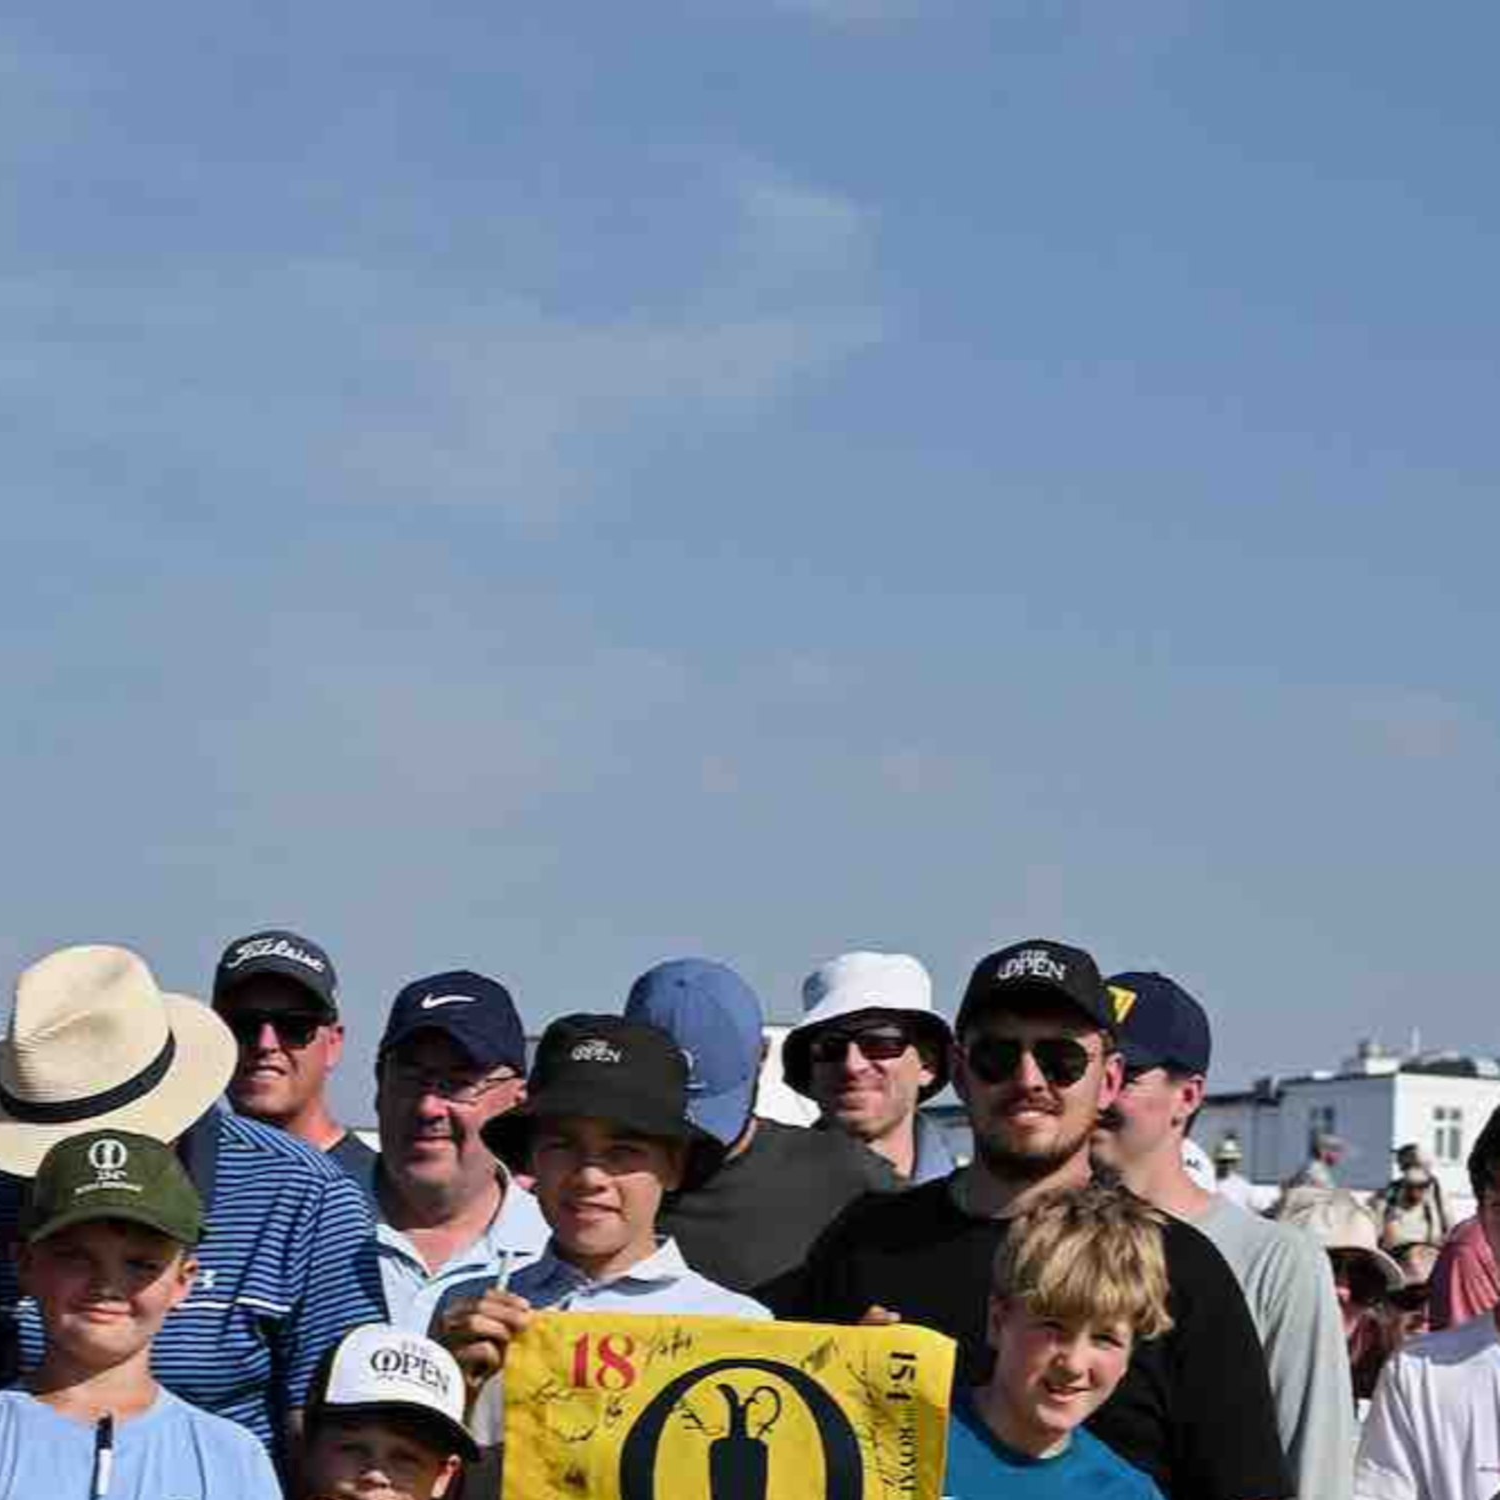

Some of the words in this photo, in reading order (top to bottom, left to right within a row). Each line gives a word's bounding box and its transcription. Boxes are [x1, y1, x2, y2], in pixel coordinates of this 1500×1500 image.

[225, 938, 327, 973] Titleist
[998, 958, 1066, 981] OPEN
[369, 1349, 451, 1396] OPEN
[569, 1331, 635, 1390] 18
[898, 1426, 917, 1494] ROYAL
